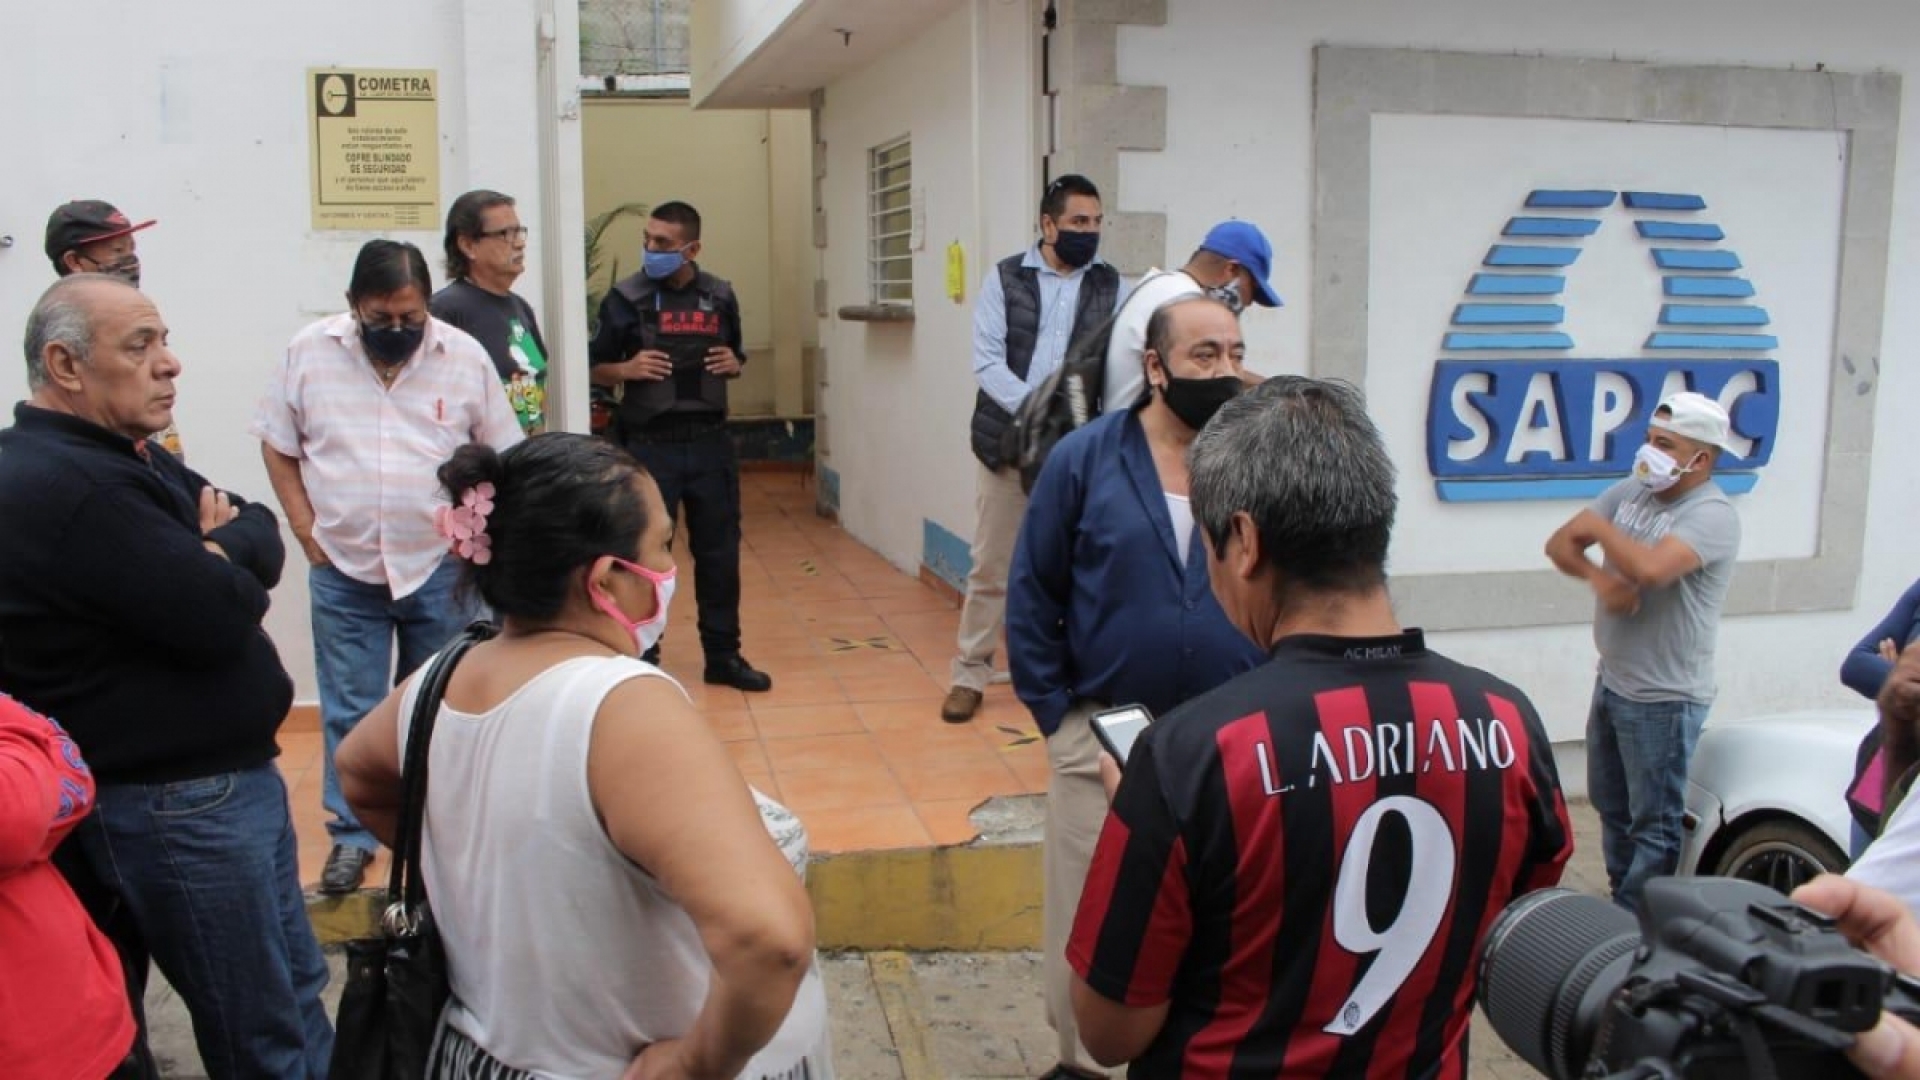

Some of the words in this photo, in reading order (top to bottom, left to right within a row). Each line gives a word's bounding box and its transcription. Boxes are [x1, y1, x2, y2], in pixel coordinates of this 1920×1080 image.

[358, 77, 431, 91] COMETRA
[1308, 718, 1515, 788] ADRIANO
[1322, 795, 1456, 1036] 9
